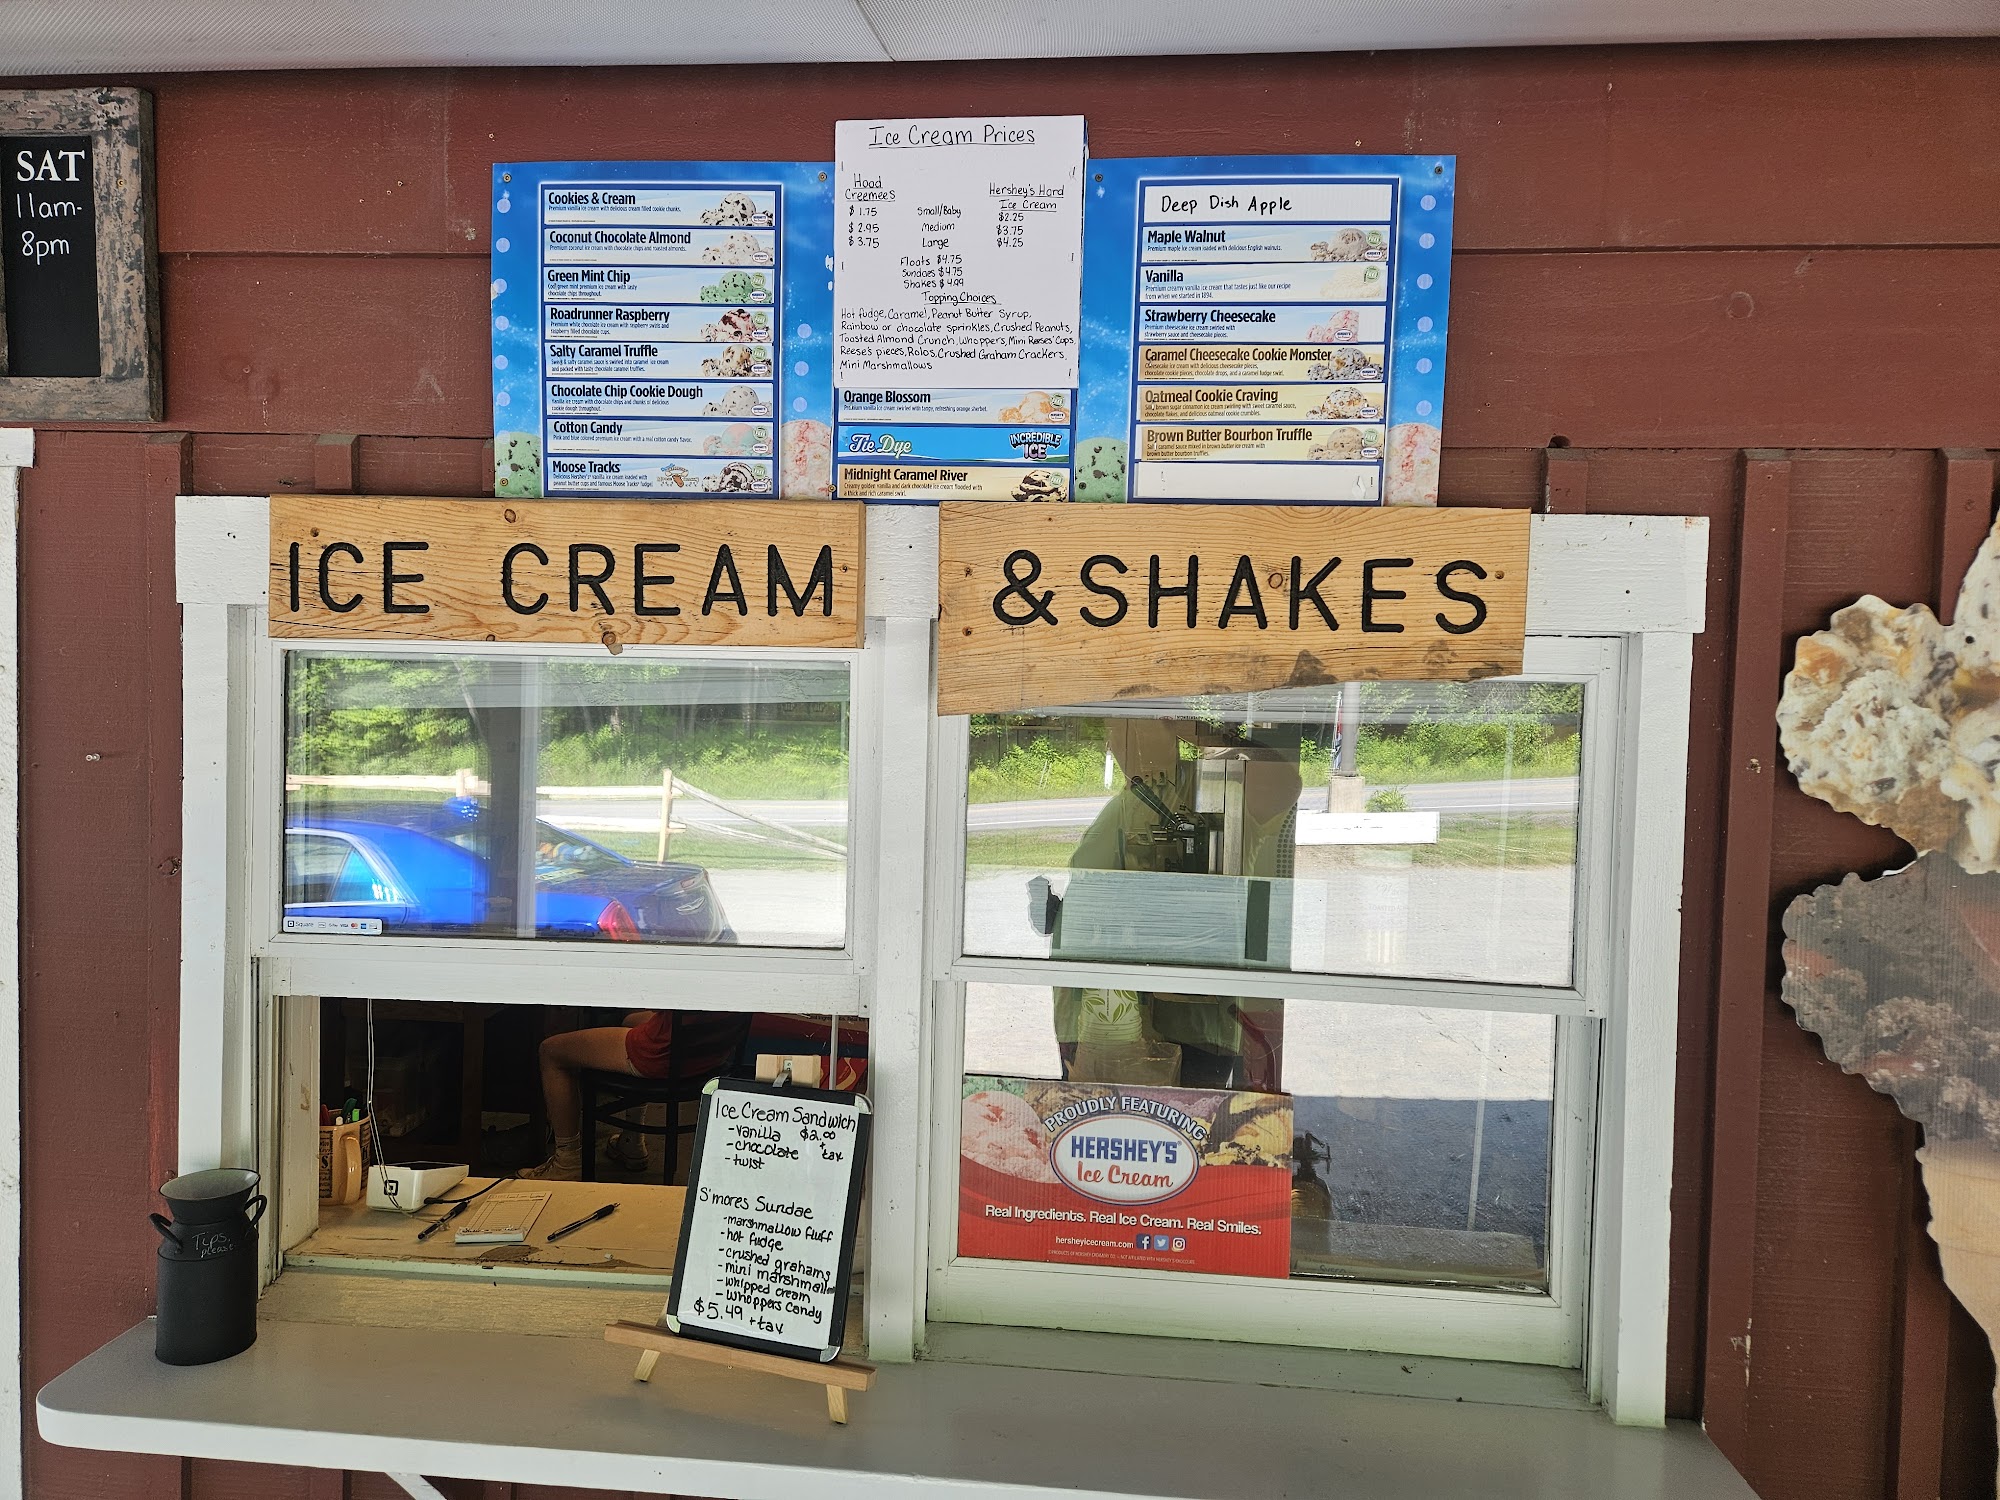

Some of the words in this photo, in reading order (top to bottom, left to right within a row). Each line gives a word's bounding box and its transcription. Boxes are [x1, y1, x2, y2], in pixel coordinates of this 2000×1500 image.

[869, 126, 900, 146] Ice
[909, 125, 972, 145] Cream
[984, 125, 1035, 143] Prices
[17, 150, 85, 181] SAT
[989, 183, 1036, 198] Hershey's
[1039, 185, 1064, 196] Hard
[17, 193, 82, 218] 11am-
[549, 192, 589, 205] Cookies
[591, 193, 599, 205] &
[602, 193, 636, 205] Cream
[1000, 199, 1016, 209] Ice
[1022, 200, 1057, 210] Cream
[1162, 196, 1197, 214] Deep
[1210, 195, 1239, 209] Dish
[1248, 197, 1292, 215] Apple
[999, 213, 1024, 223] $2.25
[550, 231, 592, 244] Coconut
[595, 231, 646, 244] Chocolate
[649, 232, 691, 244] Almond
[997, 225, 1023, 236] $3.75
[1148, 230, 1182, 245] Maple
[1185, 230, 1226, 243] Walnut
[22, 230, 70, 265] 8pm
[922, 237, 949, 249] Large
[997, 237, 1023, 248] $4.25
[900, 257, 930, 267] Floats
[937, 254, 962, 265] $4.75
[548, 270, 579, 282] Green
[582, 270, 604, 282] Mint
[608, 270, 630, 284] Chip
[902, 269, 936, 278] Sundaes
[1146, 270, 1183, 282] Vanilla
[904, 280, 937, 289] Shakes
[921, 292, 958, 306] Topping
[960, 292, 996, 304] Choices
[551, 308, 613, 320] Roadrunner
[616, 309, 670, 322] Raspberry
[841, 309, 855, 319] Hot
[932, 308, 963, 318] Peanut
[965, 308, 993, 318] Butter
[1145, 309, 1208, 324] Strawberry
[1211, 310, 1276, 323] Cheesecake
[841, 322, 878, 332] Rainbow
[897, 323, 942, 333] chocolate
[994, 323, 1032, 333] Crushed
[1035, 323, 1073, 334] Peanuts,
[839, 333, 874, 344] Toasted
[877, 334, 914, 344] Almond
[1009, 336, 1026, 345] Mini
[551, 345, 576, 359] Salty
[579, 345, 622, 357] Caramel
[625, 345, 658, 357] Truffle
[938, 349, 975, 360] Crushed
[979, 350, 1017, 360] Graham
[1145, 349, 1187, 362] Caramel
[1190, 349, 1249, 361] Cheesecake
[1253, 349, 1287, 361] Cookie
[1290, 349, 1332, 361] Monster
[840, 360, 860, 370] Mini
[863, 359, 932, 370] Marshmallows
[552, 385, 602, 397] Chocolate
[605, 385, 627, 399] Chip
[630, 385, 665, 398] Cookie
[668, 385, 703, 400] Dough
[844, 391, 883, 404] Orange
[886, 391, 931, 403] Blossom
[1145, 390, 1192, 402] Oatmeal
[1195, 389, 1233, 402] Cookie
[1236, 390, 1278, 403] Craving
[554, 421, 588, 433] Cotton
[591, 422, 623, 436] Candy
[1147, 430, 1184, 442] Brown
[1186, 429, 1222, 441] Butter
[1225, 429, 1273, 441] Bourbon
[1276, 428, 1312, 441] Truffle
[850, 434, 875, 453] Tie
[878, 435, 912, 459] Dye
[1010, 432, 1062, 449] INCREDIBLE
[1024, 444, 1047, 460] ICE
[553, 461, 586, 473] Moose
[588, 461, 621, 473] Tracks
[845, 469, 891, 481] Midnight
[894, 470, 937, 481] Caramel
[940, 470, 968, 481] River
[290, 541, 430, 613] ICE
[502, 543, 833, 617] CREAM
[716, 1098, 739, 1119] Ice
[742, 1102, 789, 1123] Cream
[793, 1107, 856, 1132] Sandwich
[1044, 1096, 1117, 1133] PROUDLY
[1121, 1096, 1206, 1141] FEATURING
[800, 1126, 836, 1141] $2.00
[1072, 1136, 1178, 1164] HERSHEY'S
[1077, 1161, 1105, 1183] Ice
[1108, 1165, 1173, 1188] Cream
[700, 1187, 749, 1210] S'mores
[755, 1196, 814, 1220] Sundae
[985, 1205, 1011, 1218] Real
[1015, 1207, 1086, 1223] Ingredients.
[1089, 1212, 1116, 1225] Real
[1119, 1213, 1137, 1225] Ice
[1140, 1215, 1184, 1229] Cream.
[1187, 1218, 1214, 1231] Real
[1217, 1220, 1262, 1234] Smiles.
[806, 1226, 833, 1242] fluff
[750, 1233, 784, 1252] fudge
[1055, 1235, 1133, 1250] hersheyicecream.com
[775, 1260, 831, 1281] grahams
[776, 1288, 811, 1303] cream
[694, 1296, 743, 1321] $5.49
